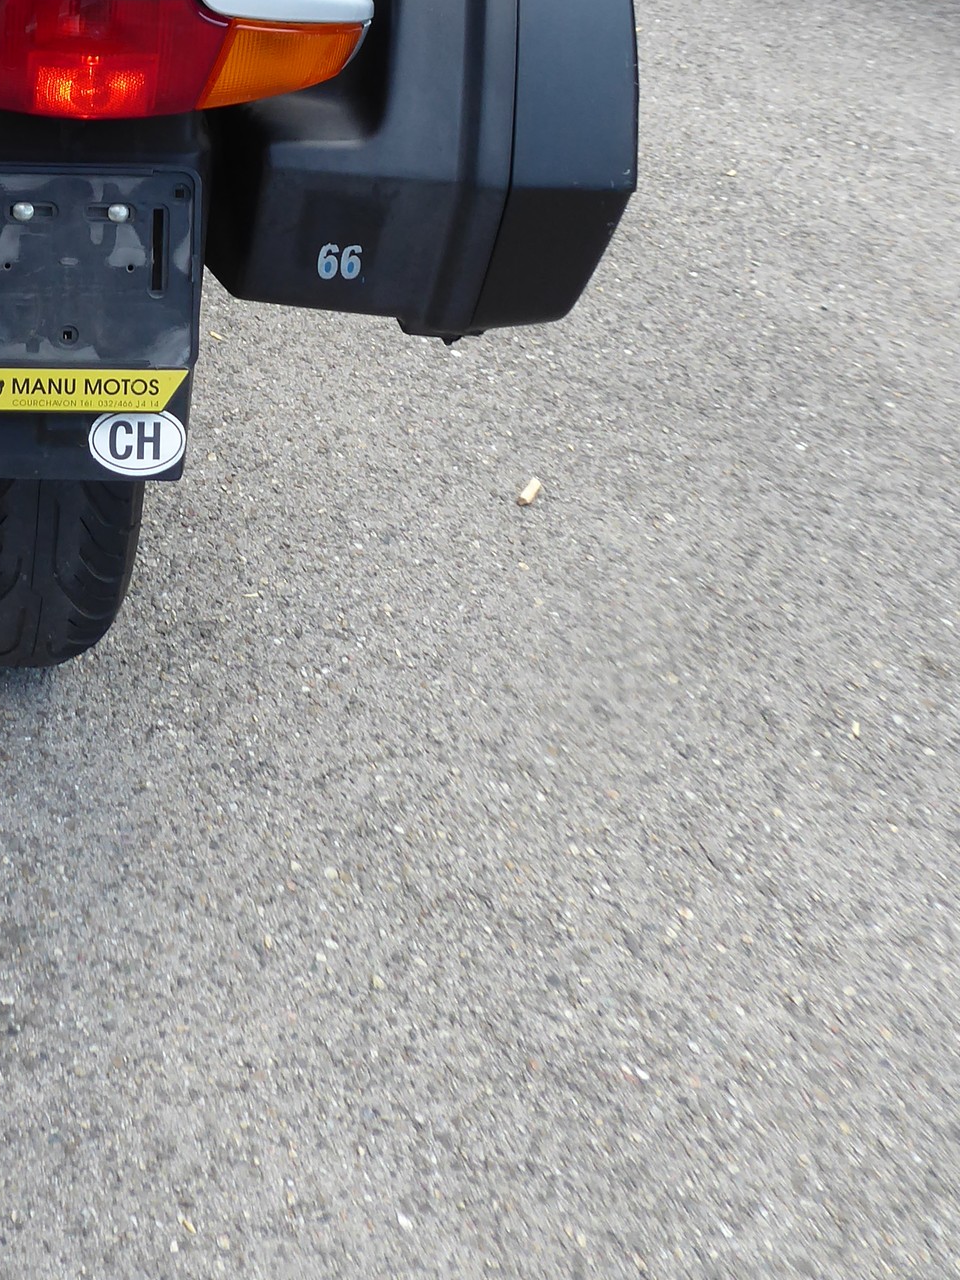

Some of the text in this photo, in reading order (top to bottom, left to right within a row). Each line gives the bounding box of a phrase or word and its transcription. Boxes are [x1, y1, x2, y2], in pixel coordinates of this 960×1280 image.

[317, 243, 363, 280] 66
[12, 378, 160, 396] MANU MOTOS
[12, 399, 77, 407] COURCHAVON
[108, 421, 161, 460] CH
